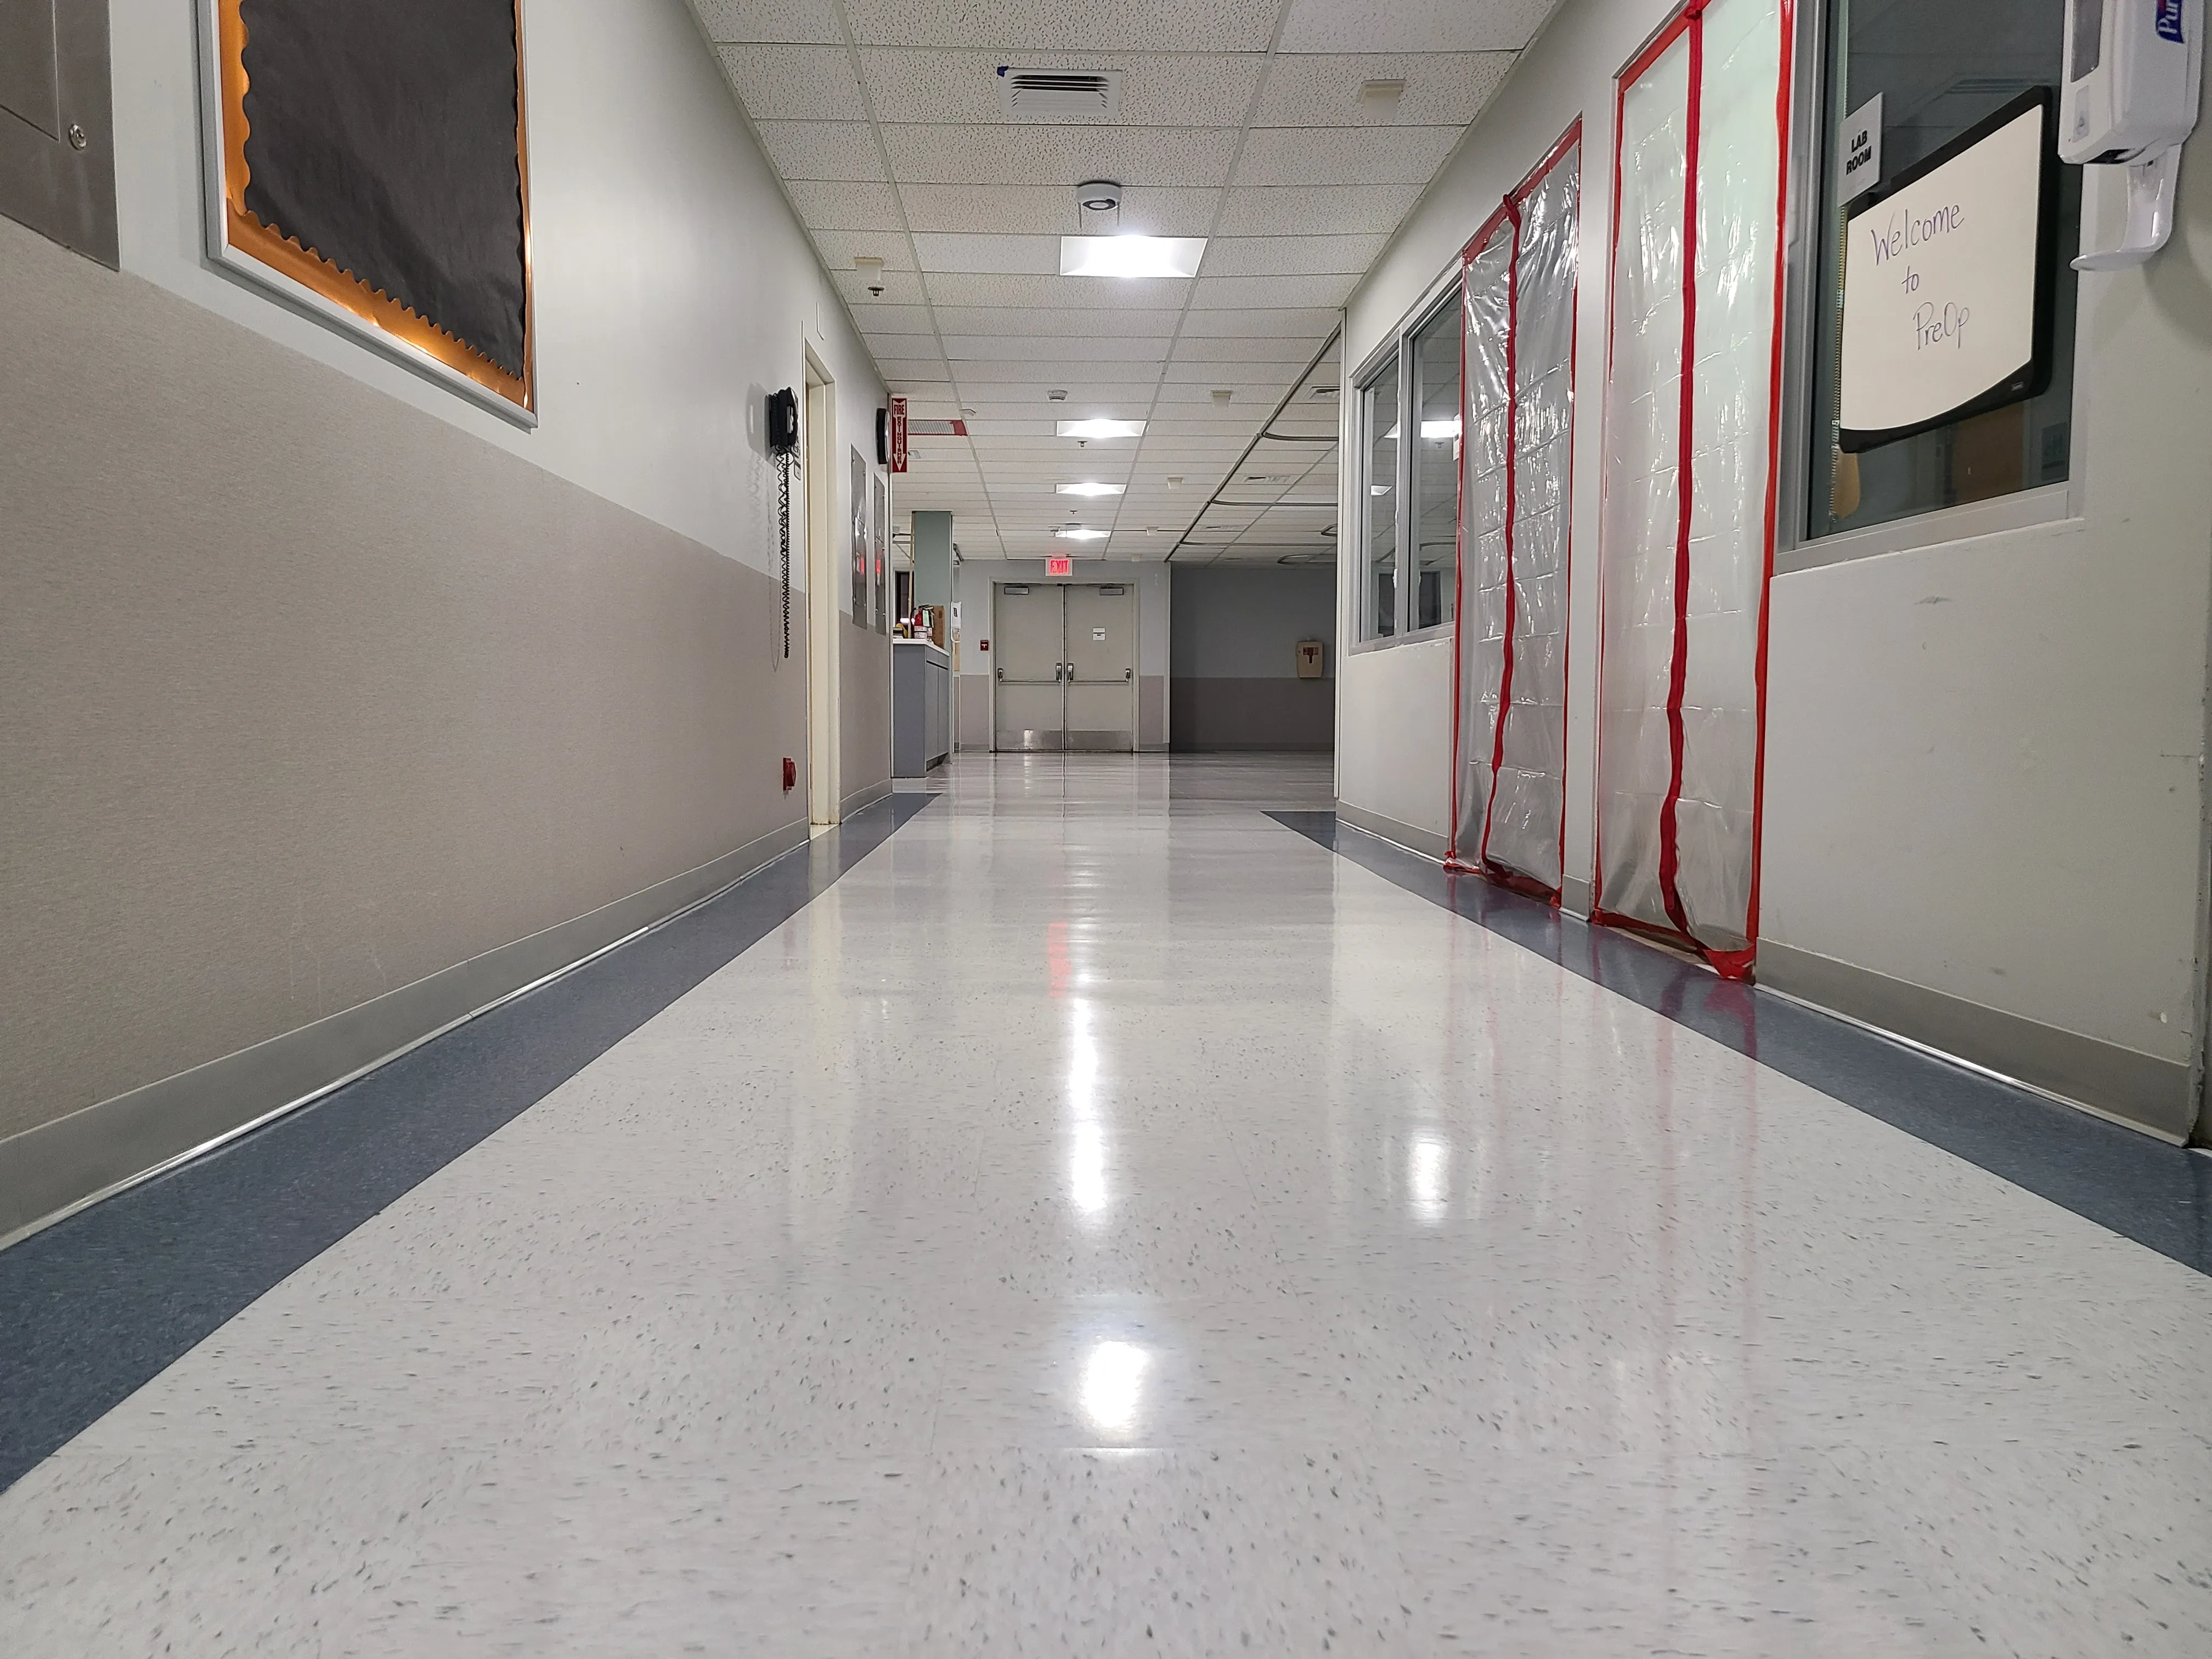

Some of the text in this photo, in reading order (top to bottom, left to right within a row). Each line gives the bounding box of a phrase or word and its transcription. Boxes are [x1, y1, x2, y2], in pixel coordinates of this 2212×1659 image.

[1851, 130, 1867, 153] LAB
[1846, 145, 1872, 176] ROOM
[1870, 205, 1965, 266] Welcome
[1901, 266, 1920, 294] to
[1912, 302, 1971, 351] PreOp
[894, 404, 905, 415] FIRE
[1050, 560, 1069, 573] EXIT
